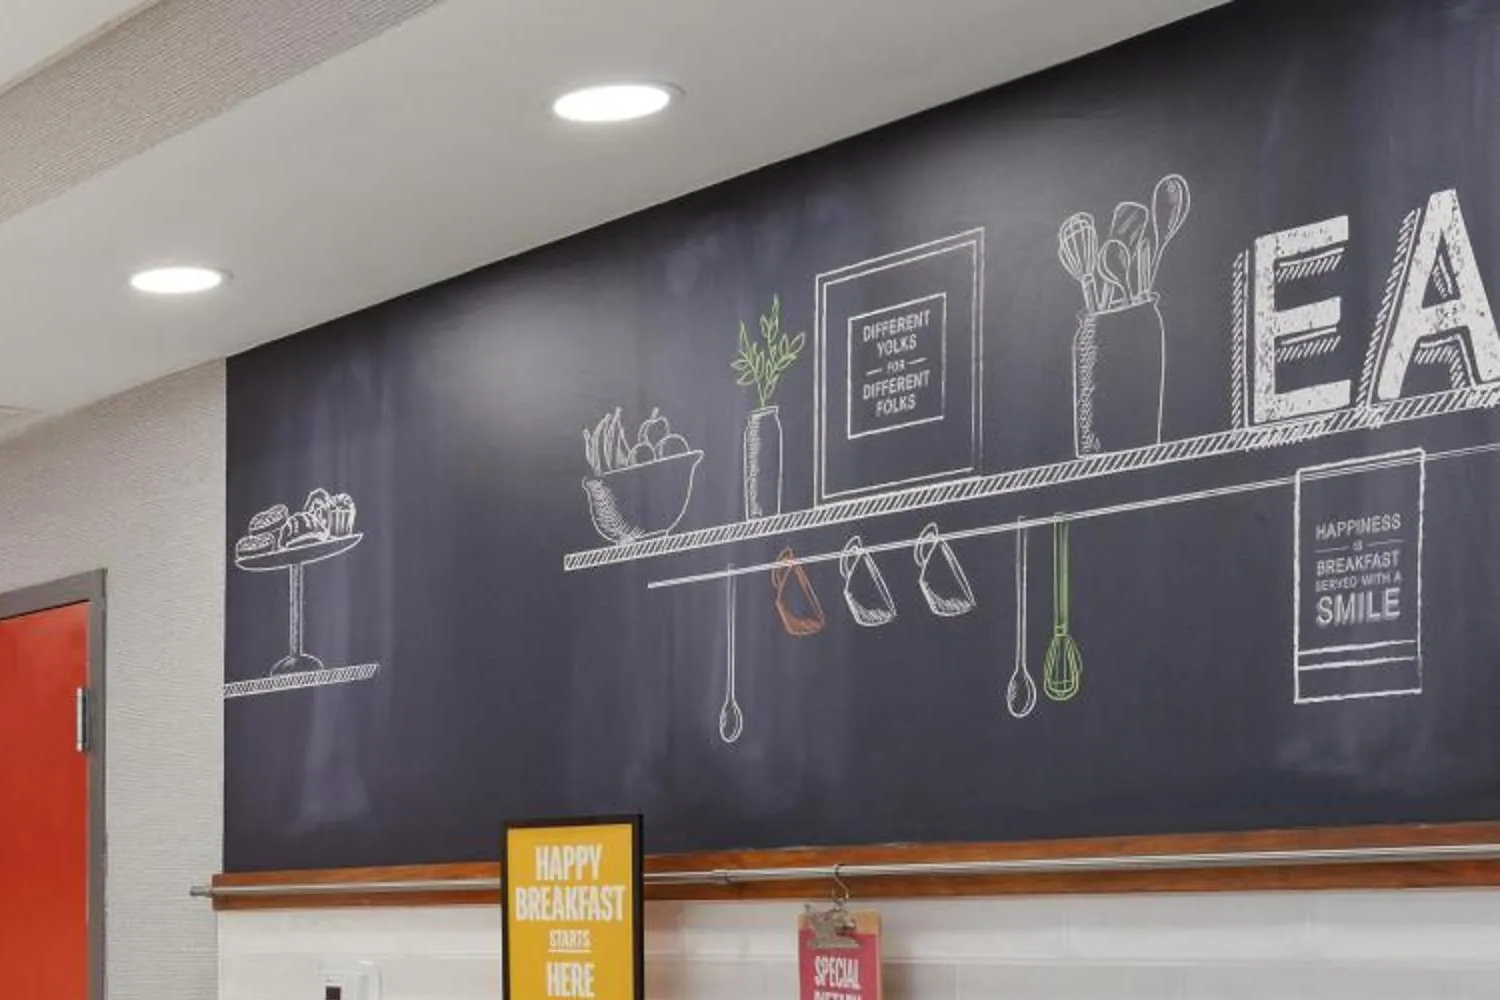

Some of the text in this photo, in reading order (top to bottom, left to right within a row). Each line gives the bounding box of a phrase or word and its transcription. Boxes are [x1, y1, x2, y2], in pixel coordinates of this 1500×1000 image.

[863, 309, 930, 342] DIFFERENT
[877, 333, 917, 358] YOLKS
[863, 369, 930, 400] DIFFERENT
[875, 393, 916, 417] FOLKS
[1315, 513, 1402, 540] HAPPINESS
[1316, 549, 1400, 577] BREAKFAST
[1315, 570, 1403, 592] SERVED WITH A
[1315, 587, 1401, 627] SMILE
[535, 844, 602, 881] HAPPY
[515, 884, 626, 922] BREAKFAST
[549, 929, 591, 948] STARTS
[546, 961, 596, 999] HERE
[814, 955, 861, 989] SPECIAL
